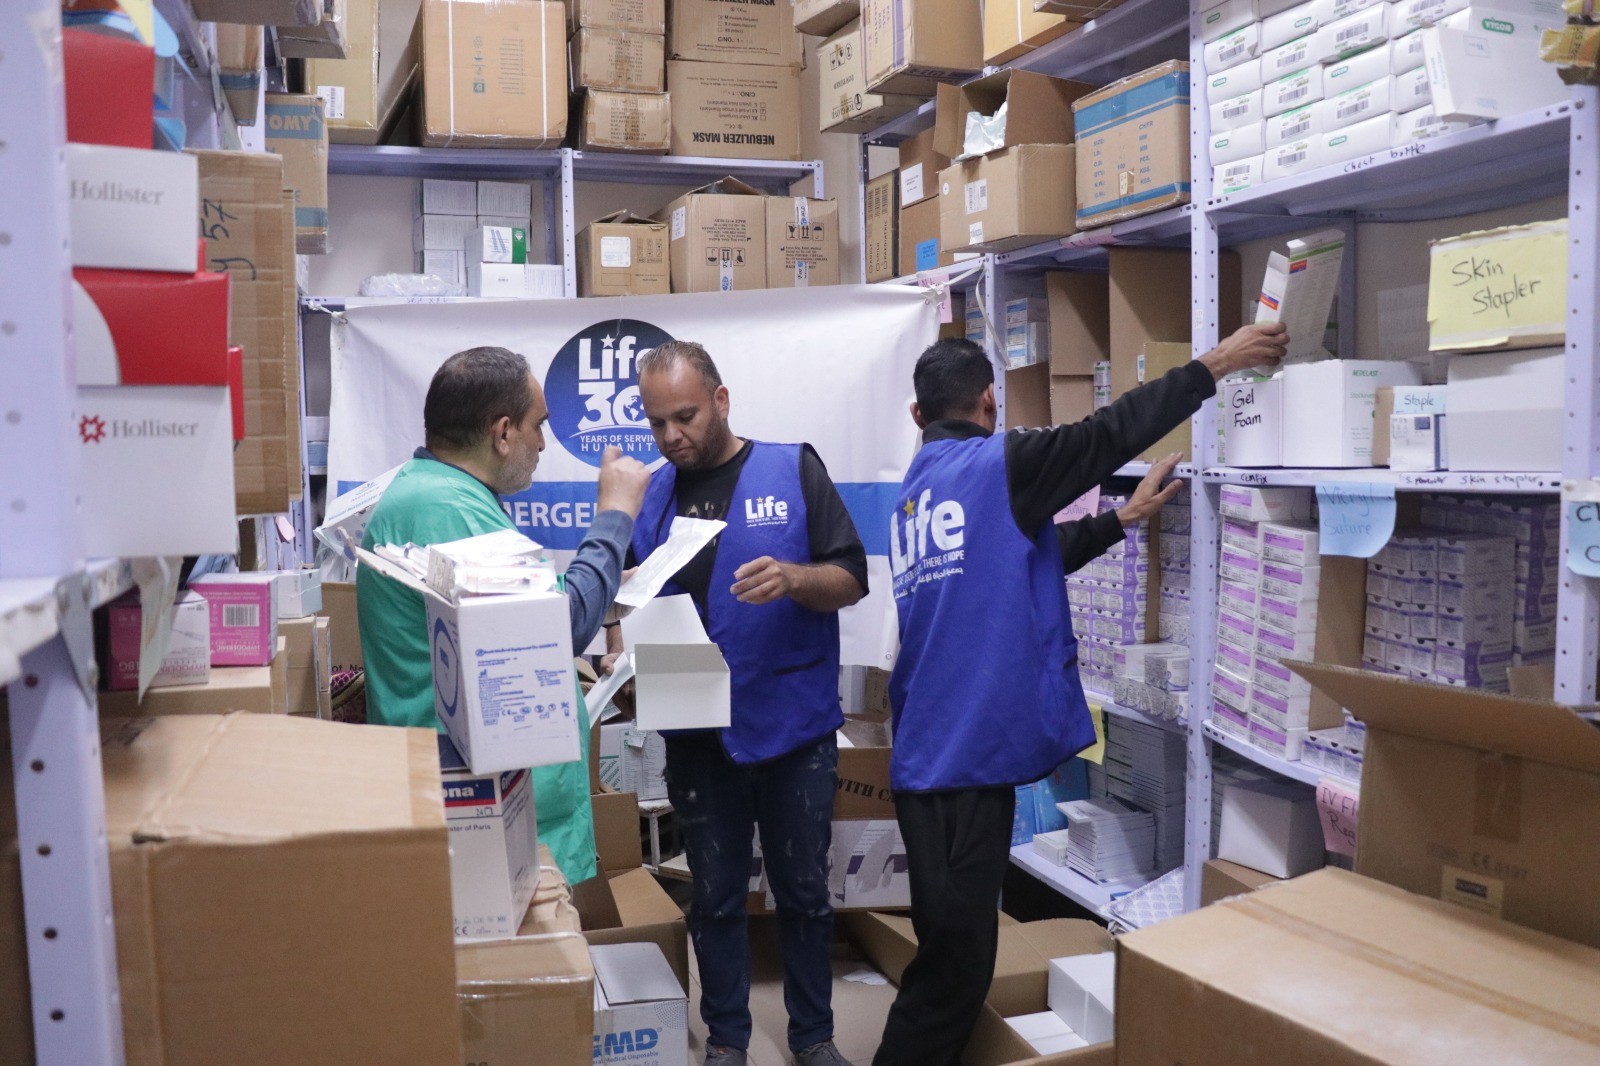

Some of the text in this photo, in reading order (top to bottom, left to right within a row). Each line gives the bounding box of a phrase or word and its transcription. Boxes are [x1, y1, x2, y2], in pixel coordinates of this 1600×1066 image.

[265, 114, 312, 131] OMY
[692, 132, 775, 145] NEBULIZER MASK
[70, 179, 164, 206] Hollister
[200, 198, 238, 241] 57
[1451, 257, 1504, 288] Skin
[1472, 275, 1542, 318] Stapler
[1232, 388, 1255, 409] Gel
[1404, 392, 1434, 411] Staple
[111, 418, 199, 438] Hollister
[1234, 411, 1262, 428] Foam
[580, 434, 656, 443] YEARS OF SERVIN
[581, 442, 660, 452] HUMANIT
[744, 495, 788, 520] Life
[890, 488, 966, 578] Life
[1324, 514, 1372, 536] Suture
[922, 555, 943, 569] THERE
[942, 554, 948, 564] IS
[947, 550, 965, 562] HOPE
[160, 663, 206, 673] HYPODERM
[442, 784, 475, 798] ona
[1321, 786, 1357, 817] IV Fl
[475, 808, 484, 817] 24
[473, 823, 491, 831] Paris
[627, 1051, 659, 1060] Disposable
